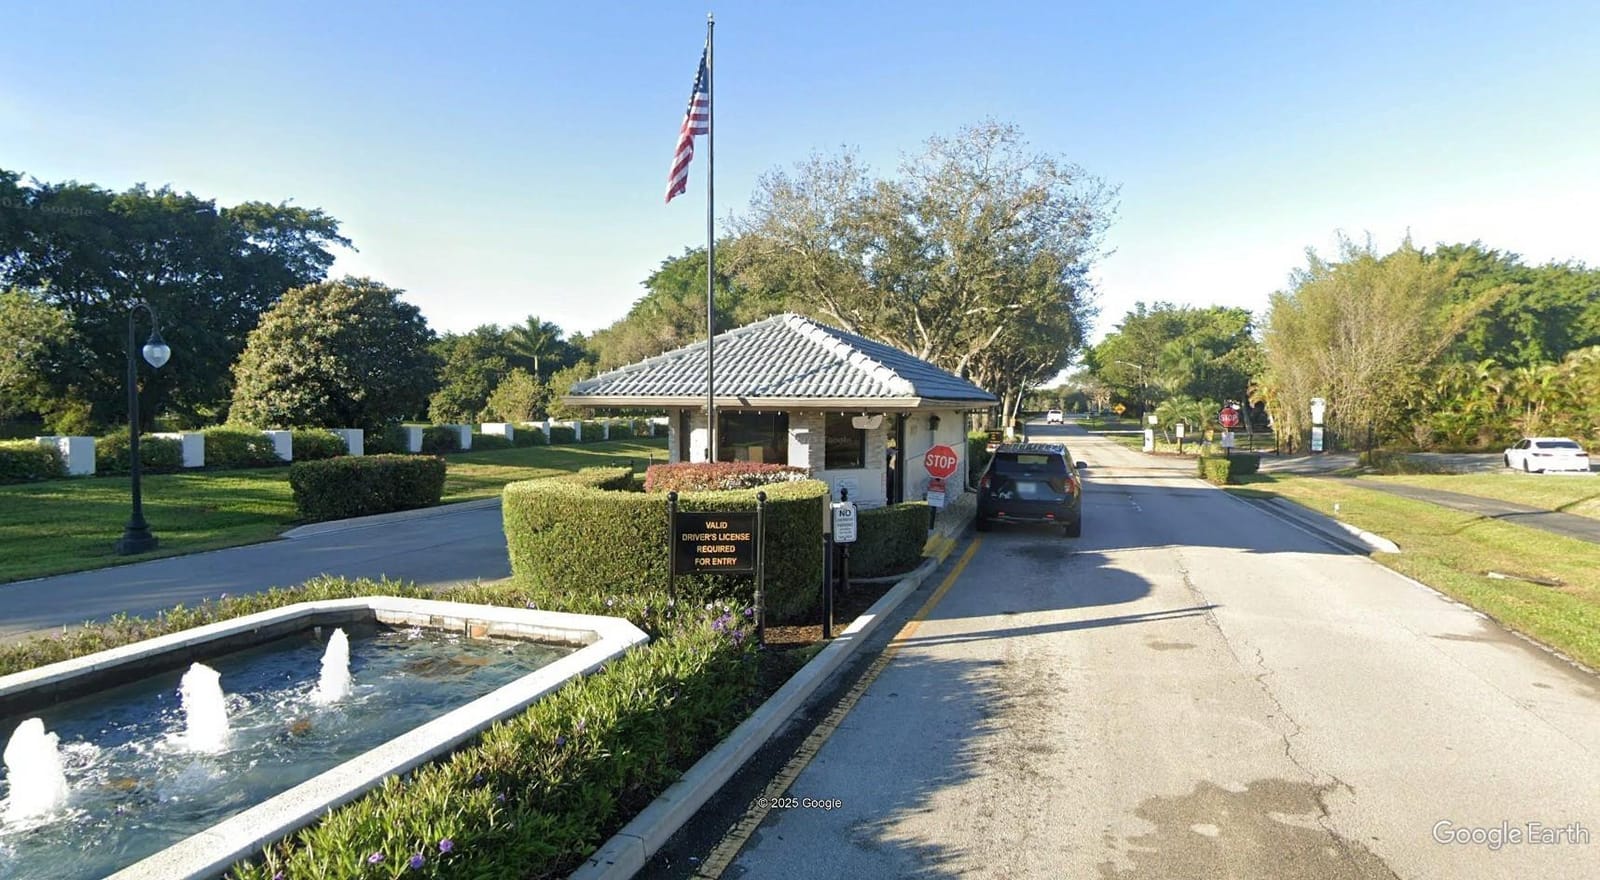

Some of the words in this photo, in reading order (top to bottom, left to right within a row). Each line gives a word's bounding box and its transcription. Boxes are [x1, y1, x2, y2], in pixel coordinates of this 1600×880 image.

[1220, 412, 1238, 422] STOP
[926, 454, 956, 469] STOP
[839, 509, 852, 517] NO
[705, 521, 728, 529] VALID
[682, 533, 717, 541] DRIVER'S
[718, 533, 751, 541] LICENSE
[697, 545, 736, 553] REQUIRED
[695, 558, 711, 566] FOR
[712, 557, 737, 566] ENTRY
